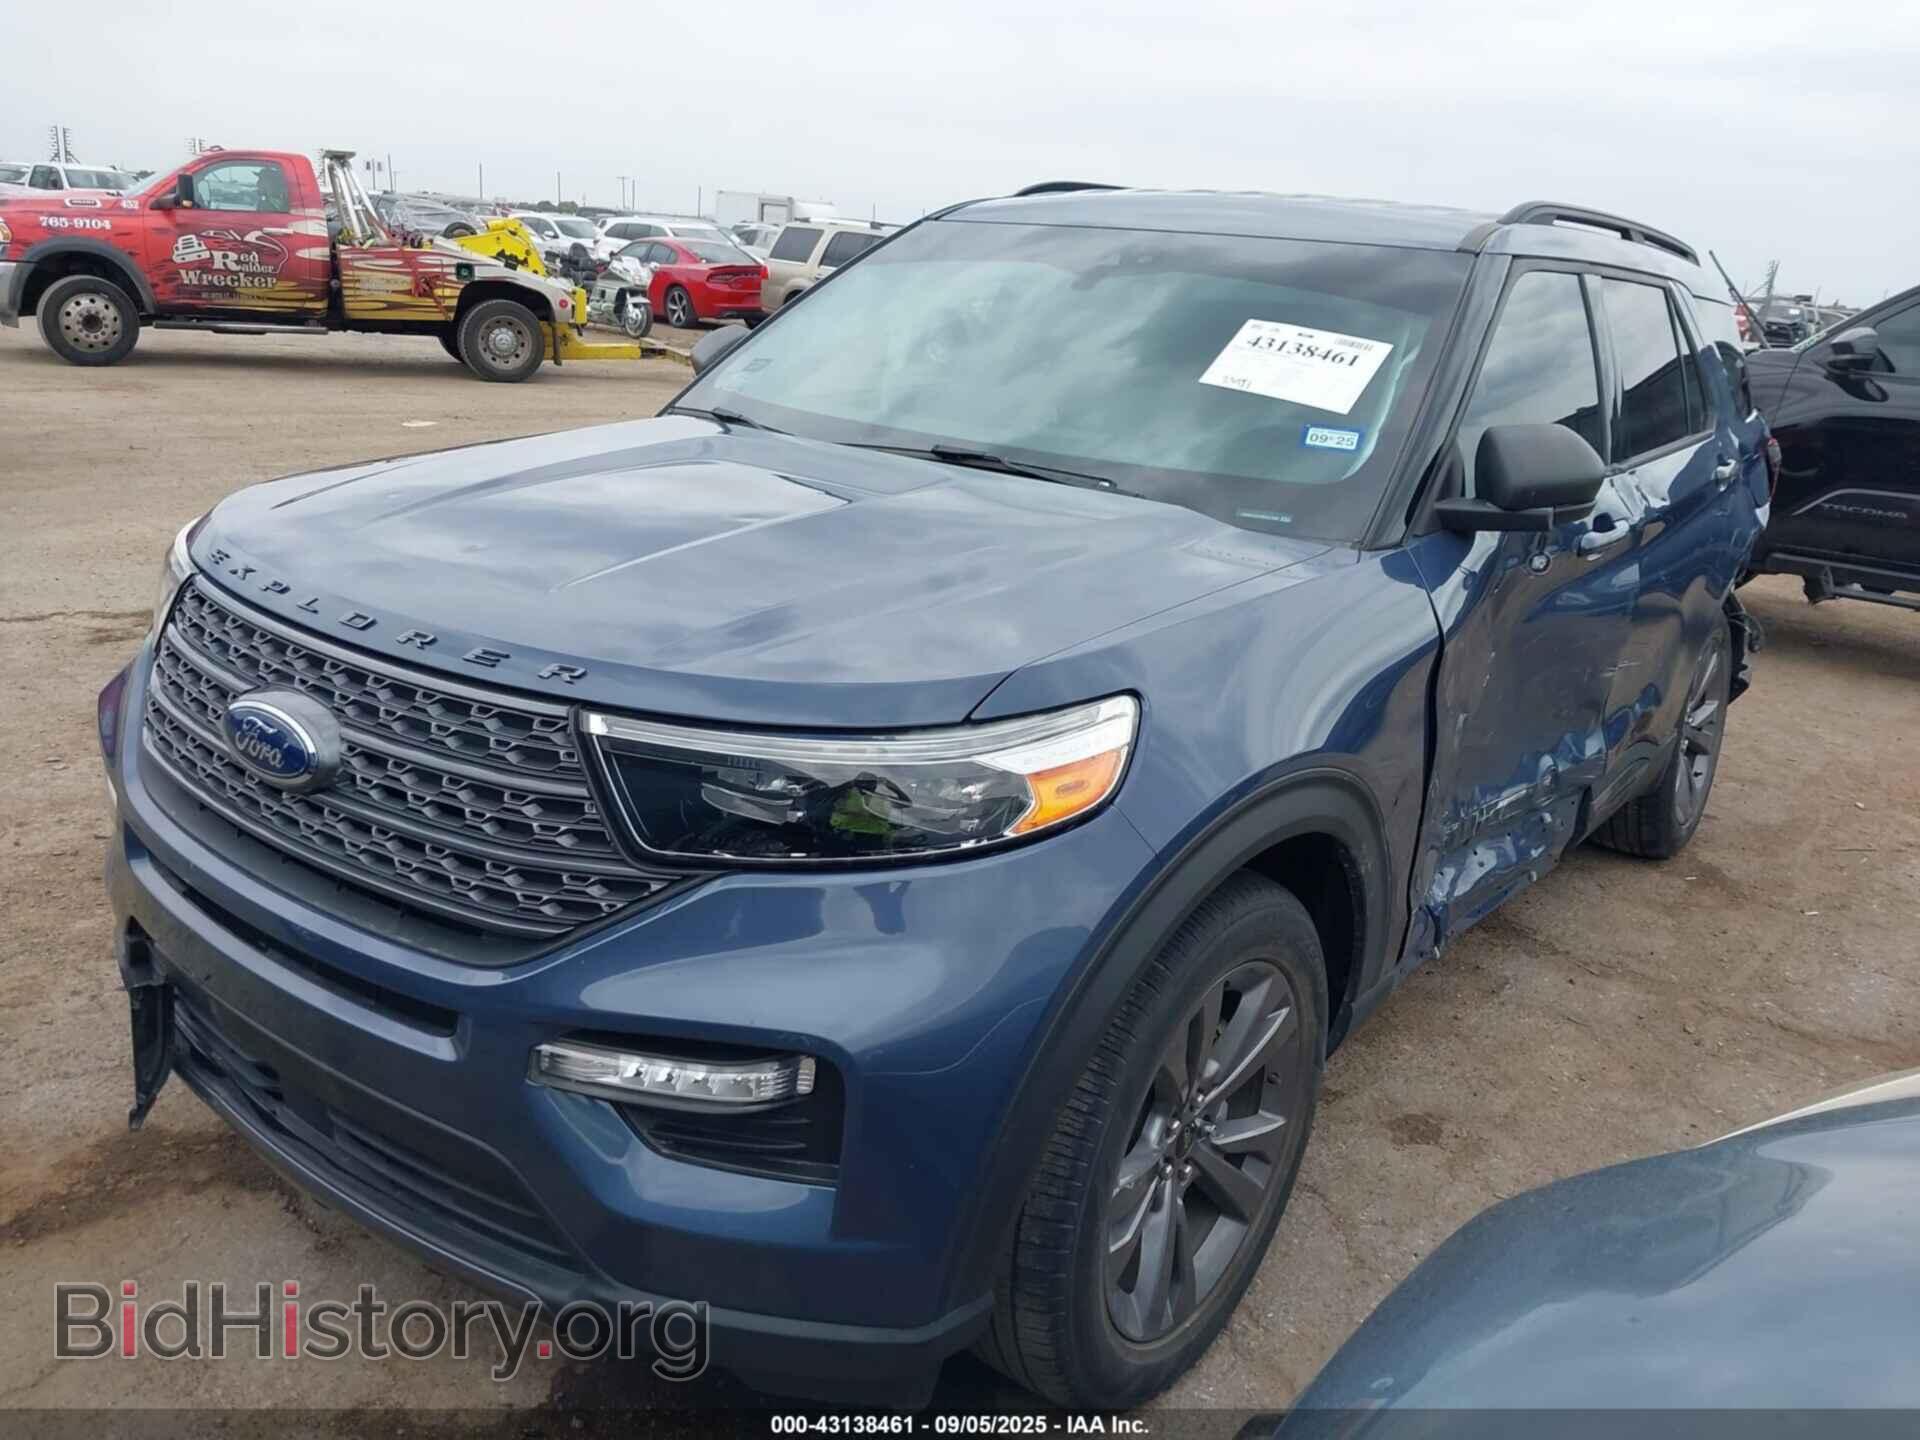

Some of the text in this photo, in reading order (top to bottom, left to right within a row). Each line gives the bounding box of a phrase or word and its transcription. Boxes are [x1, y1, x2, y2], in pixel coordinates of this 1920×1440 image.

[39, 216, 112, 230] 765-9104
[211, 249, 259, 271] Red
[178, 268, 277, 288] Wrecker
[1247, 335, 1359, 367] 43138461
[1309, 433, 1356, 447] 09 25
[209, 549, 588, 684] EXPLORER
[235, 716, 289, 768] Ford
